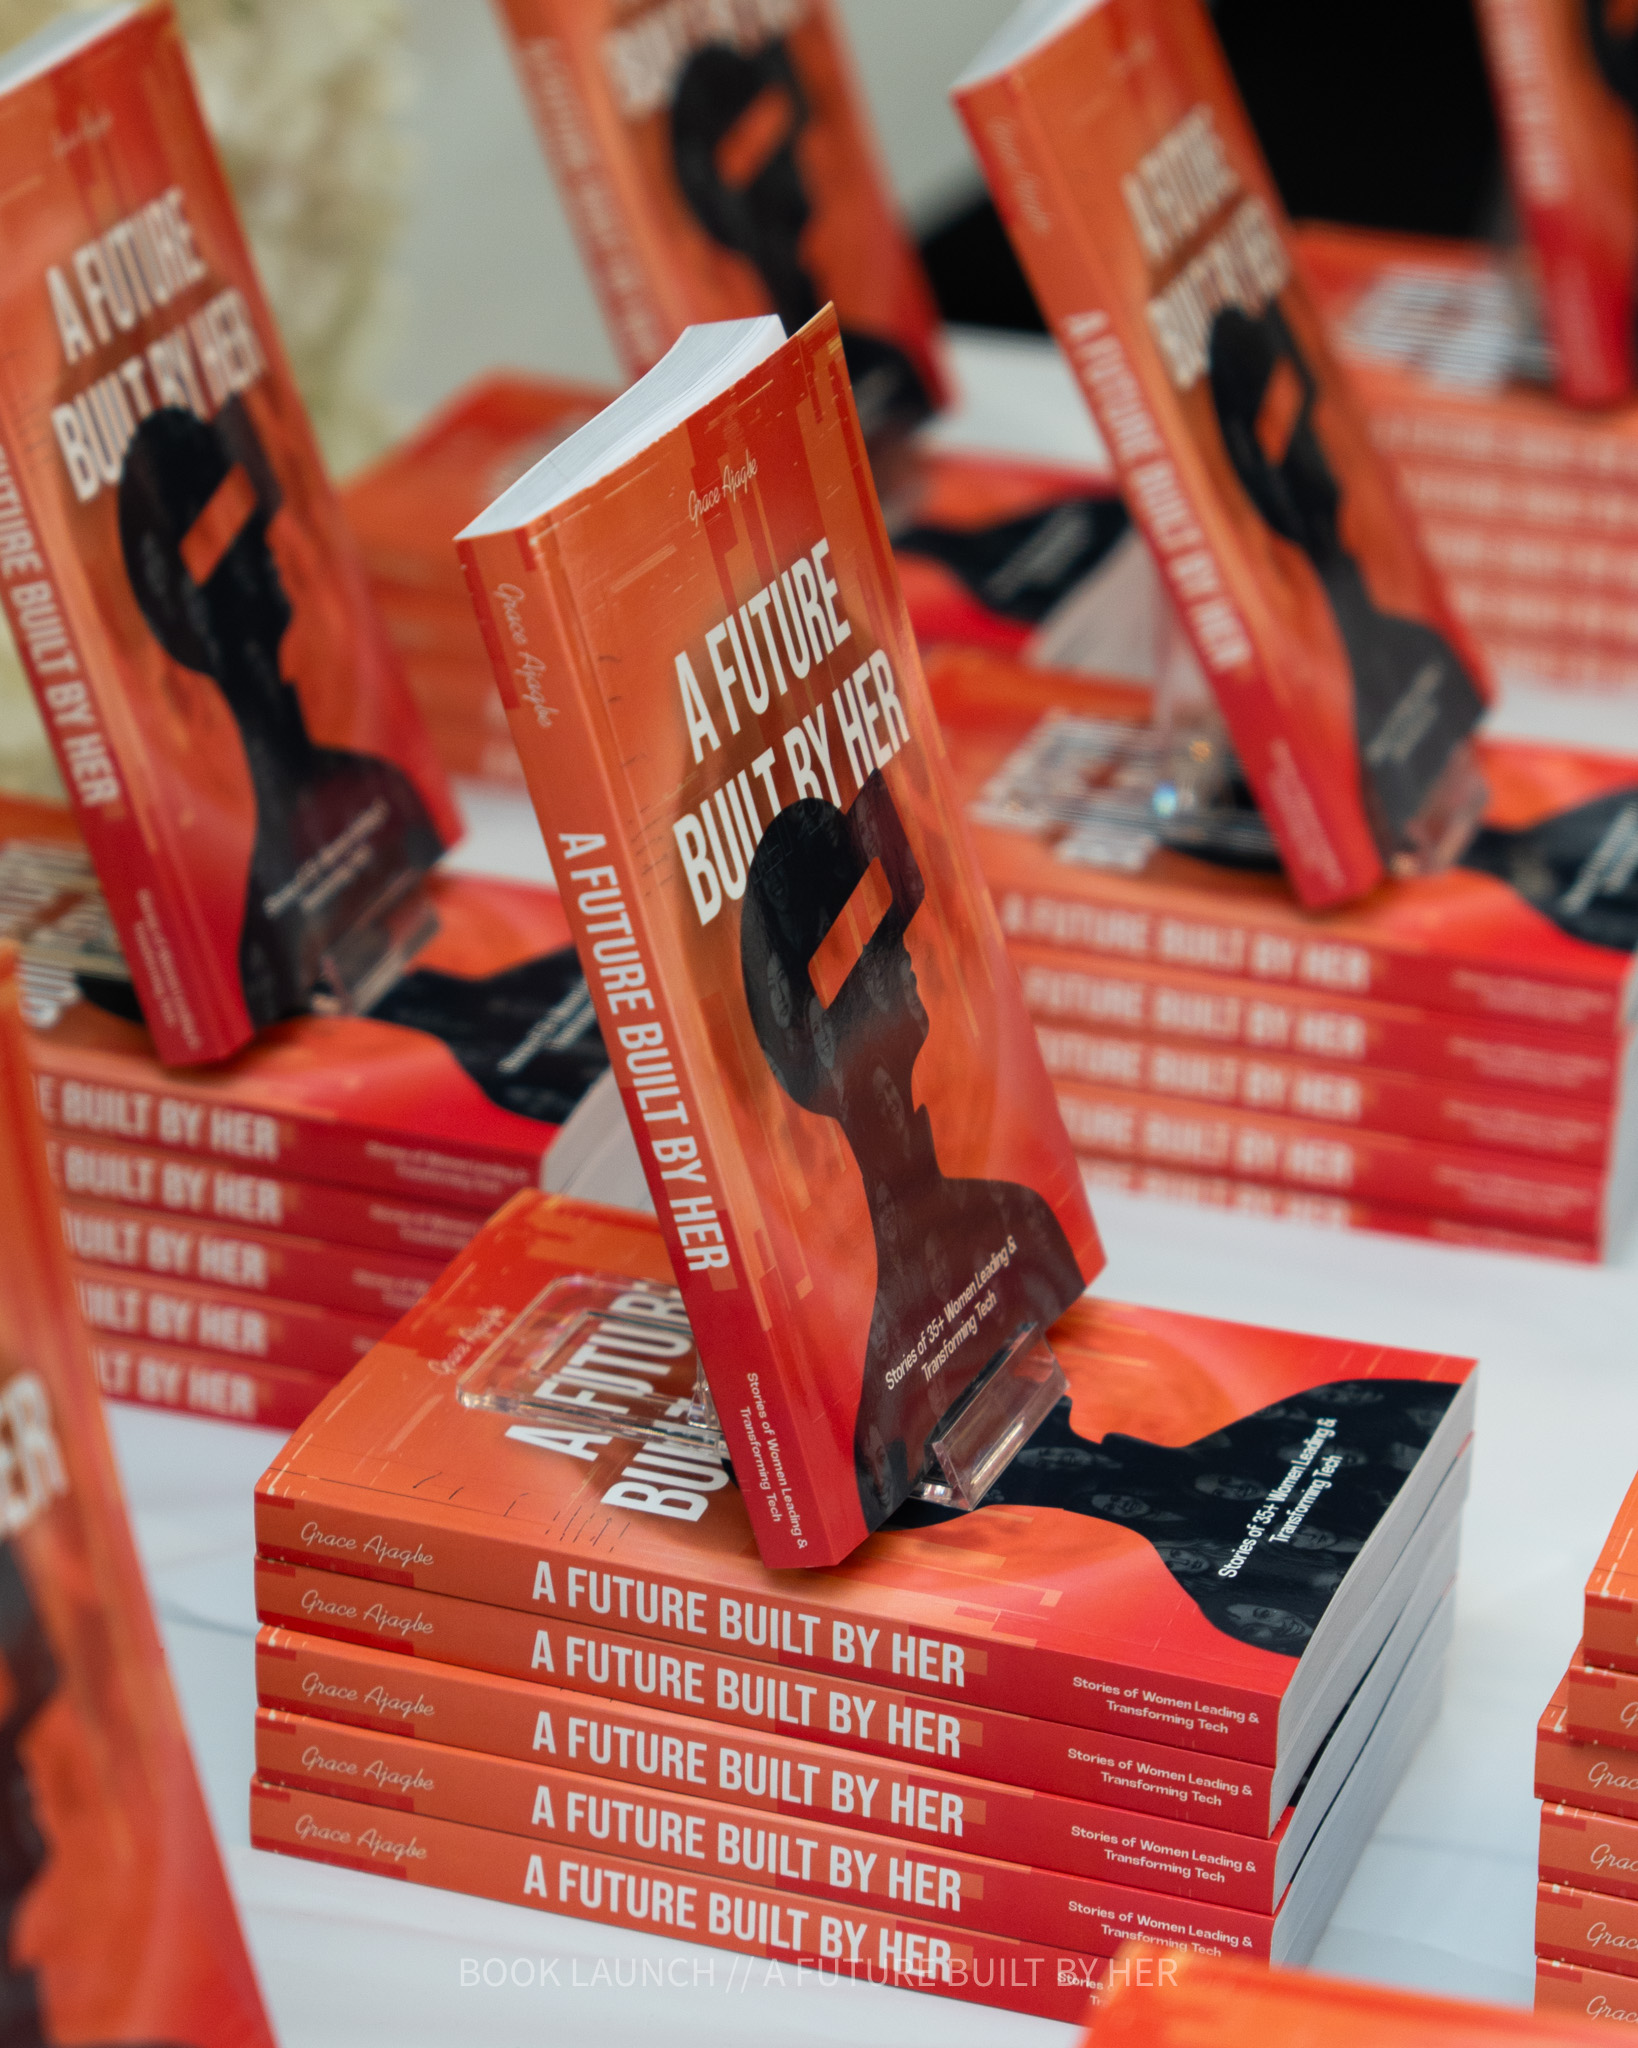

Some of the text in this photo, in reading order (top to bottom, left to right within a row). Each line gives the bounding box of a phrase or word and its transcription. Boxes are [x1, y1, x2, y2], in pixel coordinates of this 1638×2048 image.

[46, 266, 94, 364] A
[689, 448, 758, 527] Grace Ajagbe
[11, 581, 78, 674] BUILT
[493, 583, 560, 728] Grace Ajagbe
[674, 651, 721, 764] A
[705, 537, 851, 735] FUTURE
[45, 680, 95, 727] BY
[63, 732, 120, 808] HER
[672, 747, 781, 925] BUILT
[783, 703, 842, 816] BY
[832, 649, 910, 789] HER
[558, 832, 730, 1272] A FUTURE BUILT BY HER
[62, 1080, 152, 1138] BUILT
[159, 1098, 202, 1147] BY
[210, 1106, 280, 1163] HER
[65, 1146, 155, 1202] BUILT
[162, 1162, 206, 1211] BY
[213, 1169, 283, 1225] HER
[147, 1225, 191, 1275] BY
[198, 1235, 269, 1290] HER
[147, 1292, 269, 1358] BY HER
[885, 1234, 1018, 1390] Stories of 35+ Women Leading &
[921, 1289, 998, 1383] Transforming Tech
[137, 1356, 180, 1404] BY
[188, 1366, 257, 1420] HER
[505, 1281, 694, 1462] A FUTUR
[740, 1406, 783, 1522] Transforming Tech
[747, 1372, 808, 1549] Stories of Women Leading &
[1218, 1417, 1338, 1578] Stories of 35+ Women Leading &
[1269, 1454, 1343, 1543] Transforming Tech
[301, 1521, 434, 1567] Grace Ajagbe
[301, 1590, 434, 1636] Grace Ajagbe
[532, 1560, 965, 1688] A FUTURE BUILT BY HER
[302, 1672, 435, 1719] Grace Ajagbe
[531, 1630, 961, 1759] A FUTURE BUILT BY HER
[1073, 1676, 1260, 1724] Stories of Women Leading &
[1106, 1699, 1229, 1734] Transforming Tech
[302, 1746, 434, 1792] Grace Ajagbe
[532, 1711, 964, 1837] A FUTURE BUILT BY HER
[1067, 1748, 1253, 1797] Stories of Women Leading &
[1100, 1771, 1222, 1806] Transforming Tech
[1588, 1761, 1638, 1790] Grac
[295, 1814, 427, 1861] Grace Ajagbe
[531, 1785, 961, 1912] A FUTURE BUILT BY HER
[1071, 1825, 1257, 1873] Stories of Women Leading &
[1104, 1849, 1225, 1884] Transforming Tech
[1590, 1843, 1638, 1871] Grac
[523, 1854, 951, 1983] A FUTURE BUILT BY HER
[1068, 1900, 1253, 1948] Stories of Women Leading &
[1101, 1924, 1222, 1958] Transforming Tech
[1586, 1921, 1638, 1949] Grac
[1586, 1995, 1638, 2023] Grac
